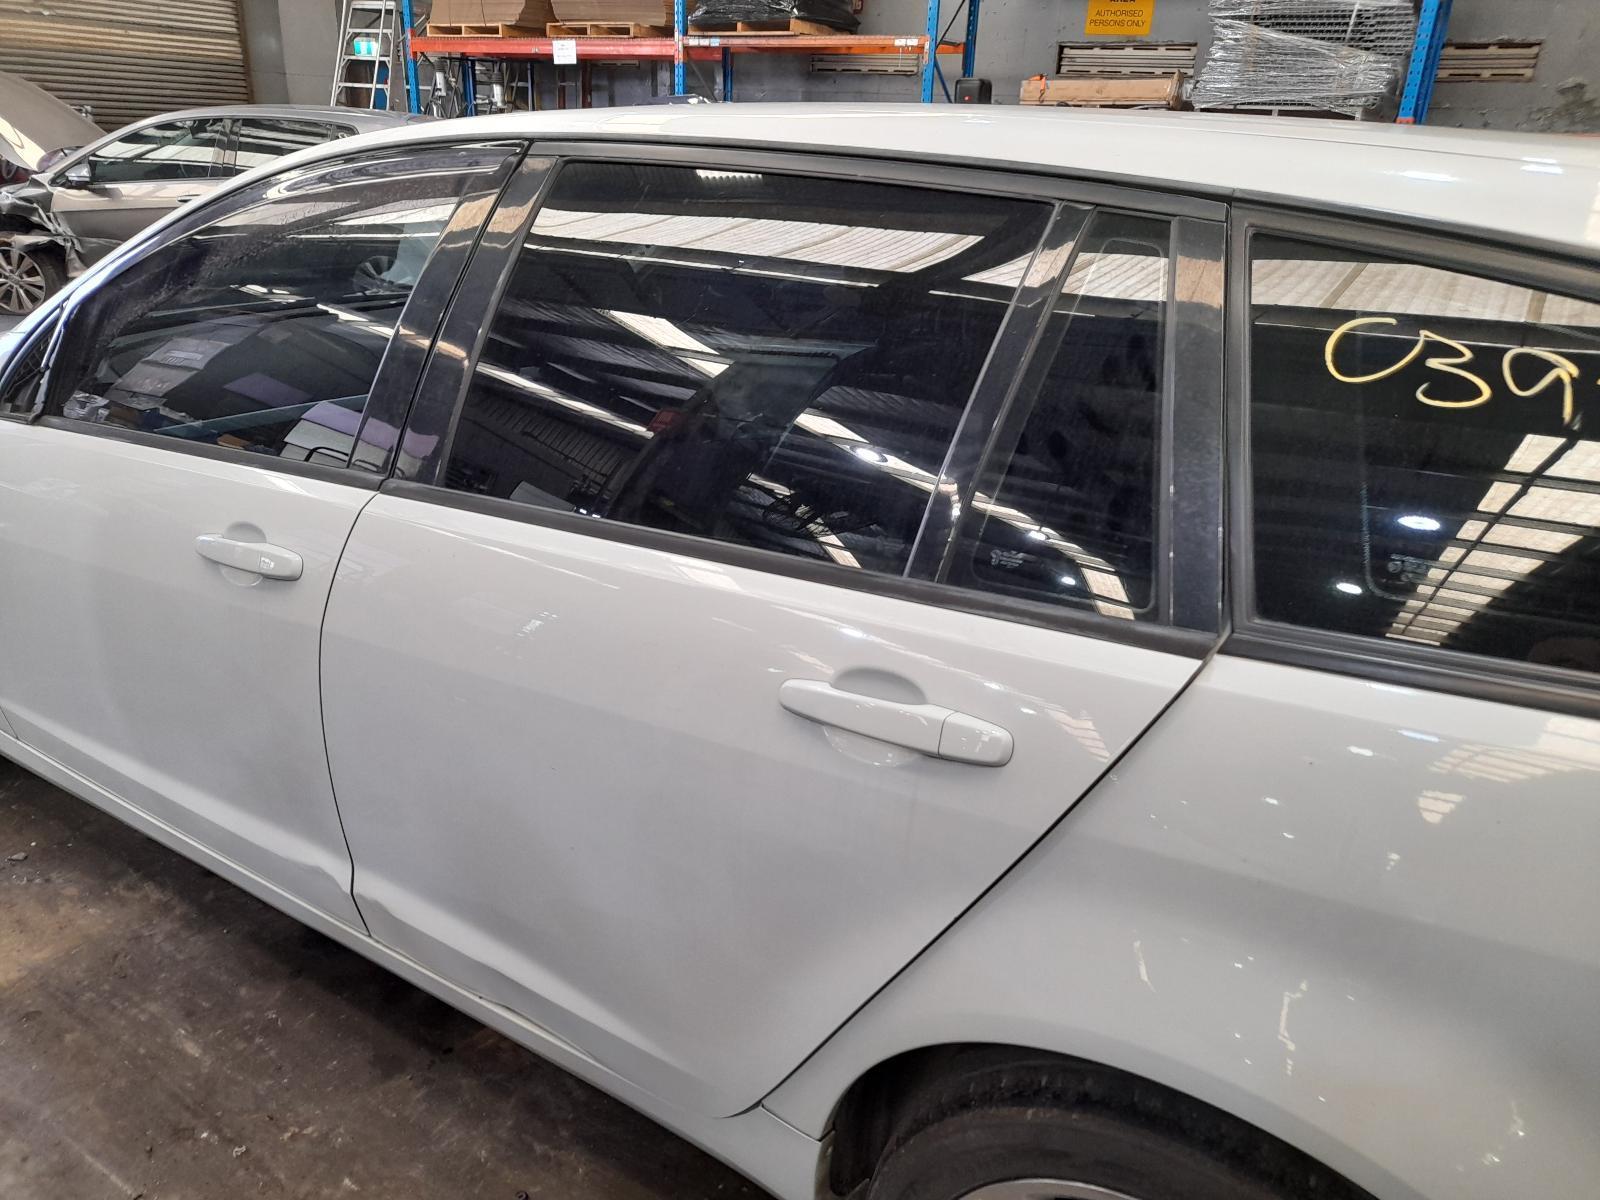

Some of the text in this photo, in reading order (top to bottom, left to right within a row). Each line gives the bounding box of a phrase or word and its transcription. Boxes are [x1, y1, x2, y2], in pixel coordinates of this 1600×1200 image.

[1095, 9, 1144, 17] AUTHORISED
[1089, 19, 1146, 27] PERSONS ONLY
